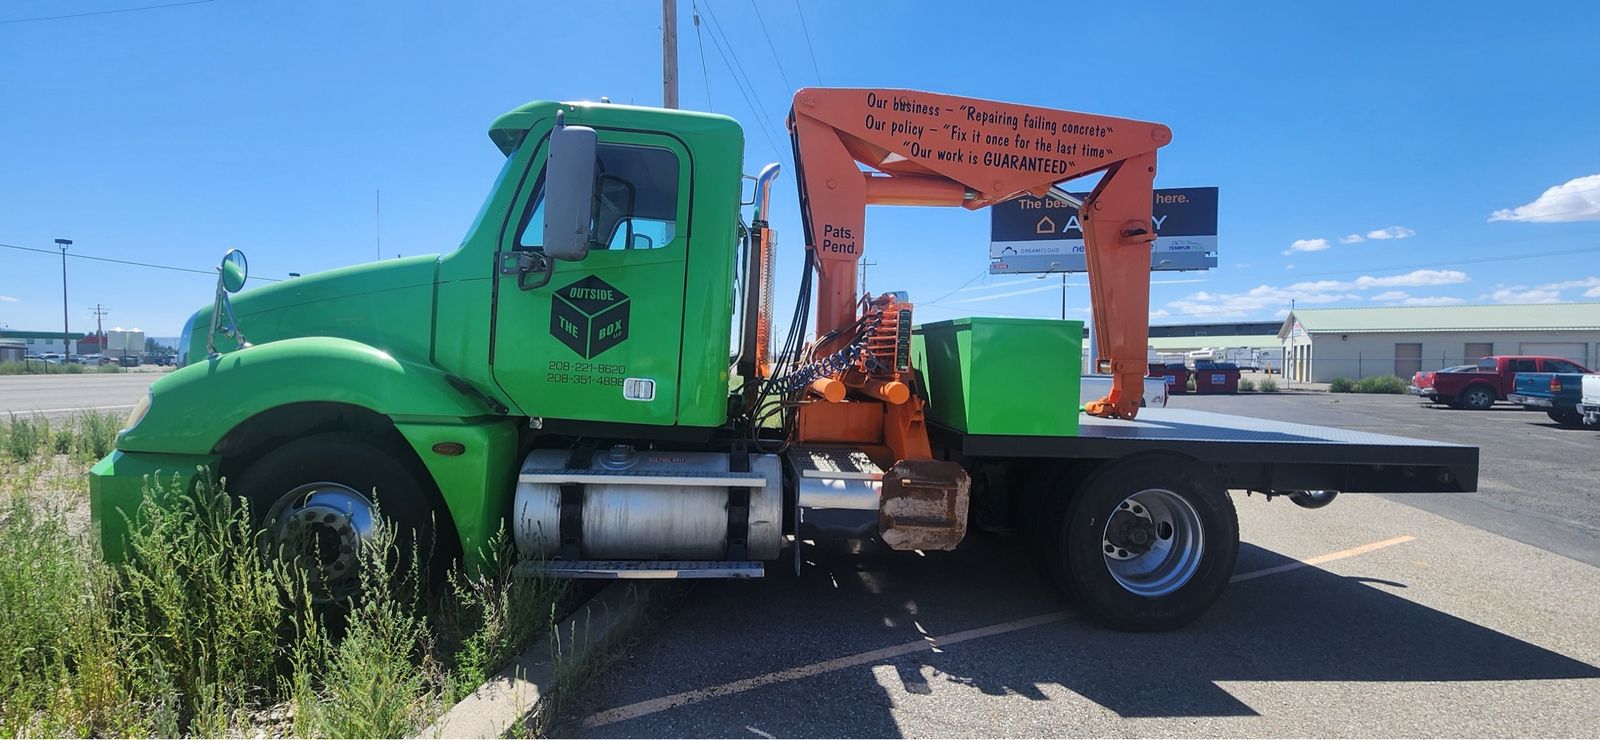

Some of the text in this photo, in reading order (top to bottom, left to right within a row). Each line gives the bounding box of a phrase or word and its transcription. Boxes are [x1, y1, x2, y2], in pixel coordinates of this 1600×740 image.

[867, 92, 888, 109] Our
[893, 96, 940, 116] business
[1023, 113, 1057, 136] failing
[865, 114, 886, 131] Our
[891, 120, 924, 140] policy
[972, 130, 981, 143] it
[985, 134, 1009, 147] once
[1015, 133, 1030, 149] for
[1035, 136, 1052, 152] the
[1056, 139, 1077, 155] last
[937, 148, 964, 163] work
[968, 150, 978, 165] is
[1018, 199, 1042, 210] The
[1156, 193, 1190, 204] here.
[824, 224, 855, 240] Pats.
[822, 239, 858, 255] Pend.
[569, 287, 614, 301] OUTSIDE
[558, 315, 579, 339] THE
[598, 319, 622, 341] BOX
[548, 360, 626, 375] 208-221-8620
